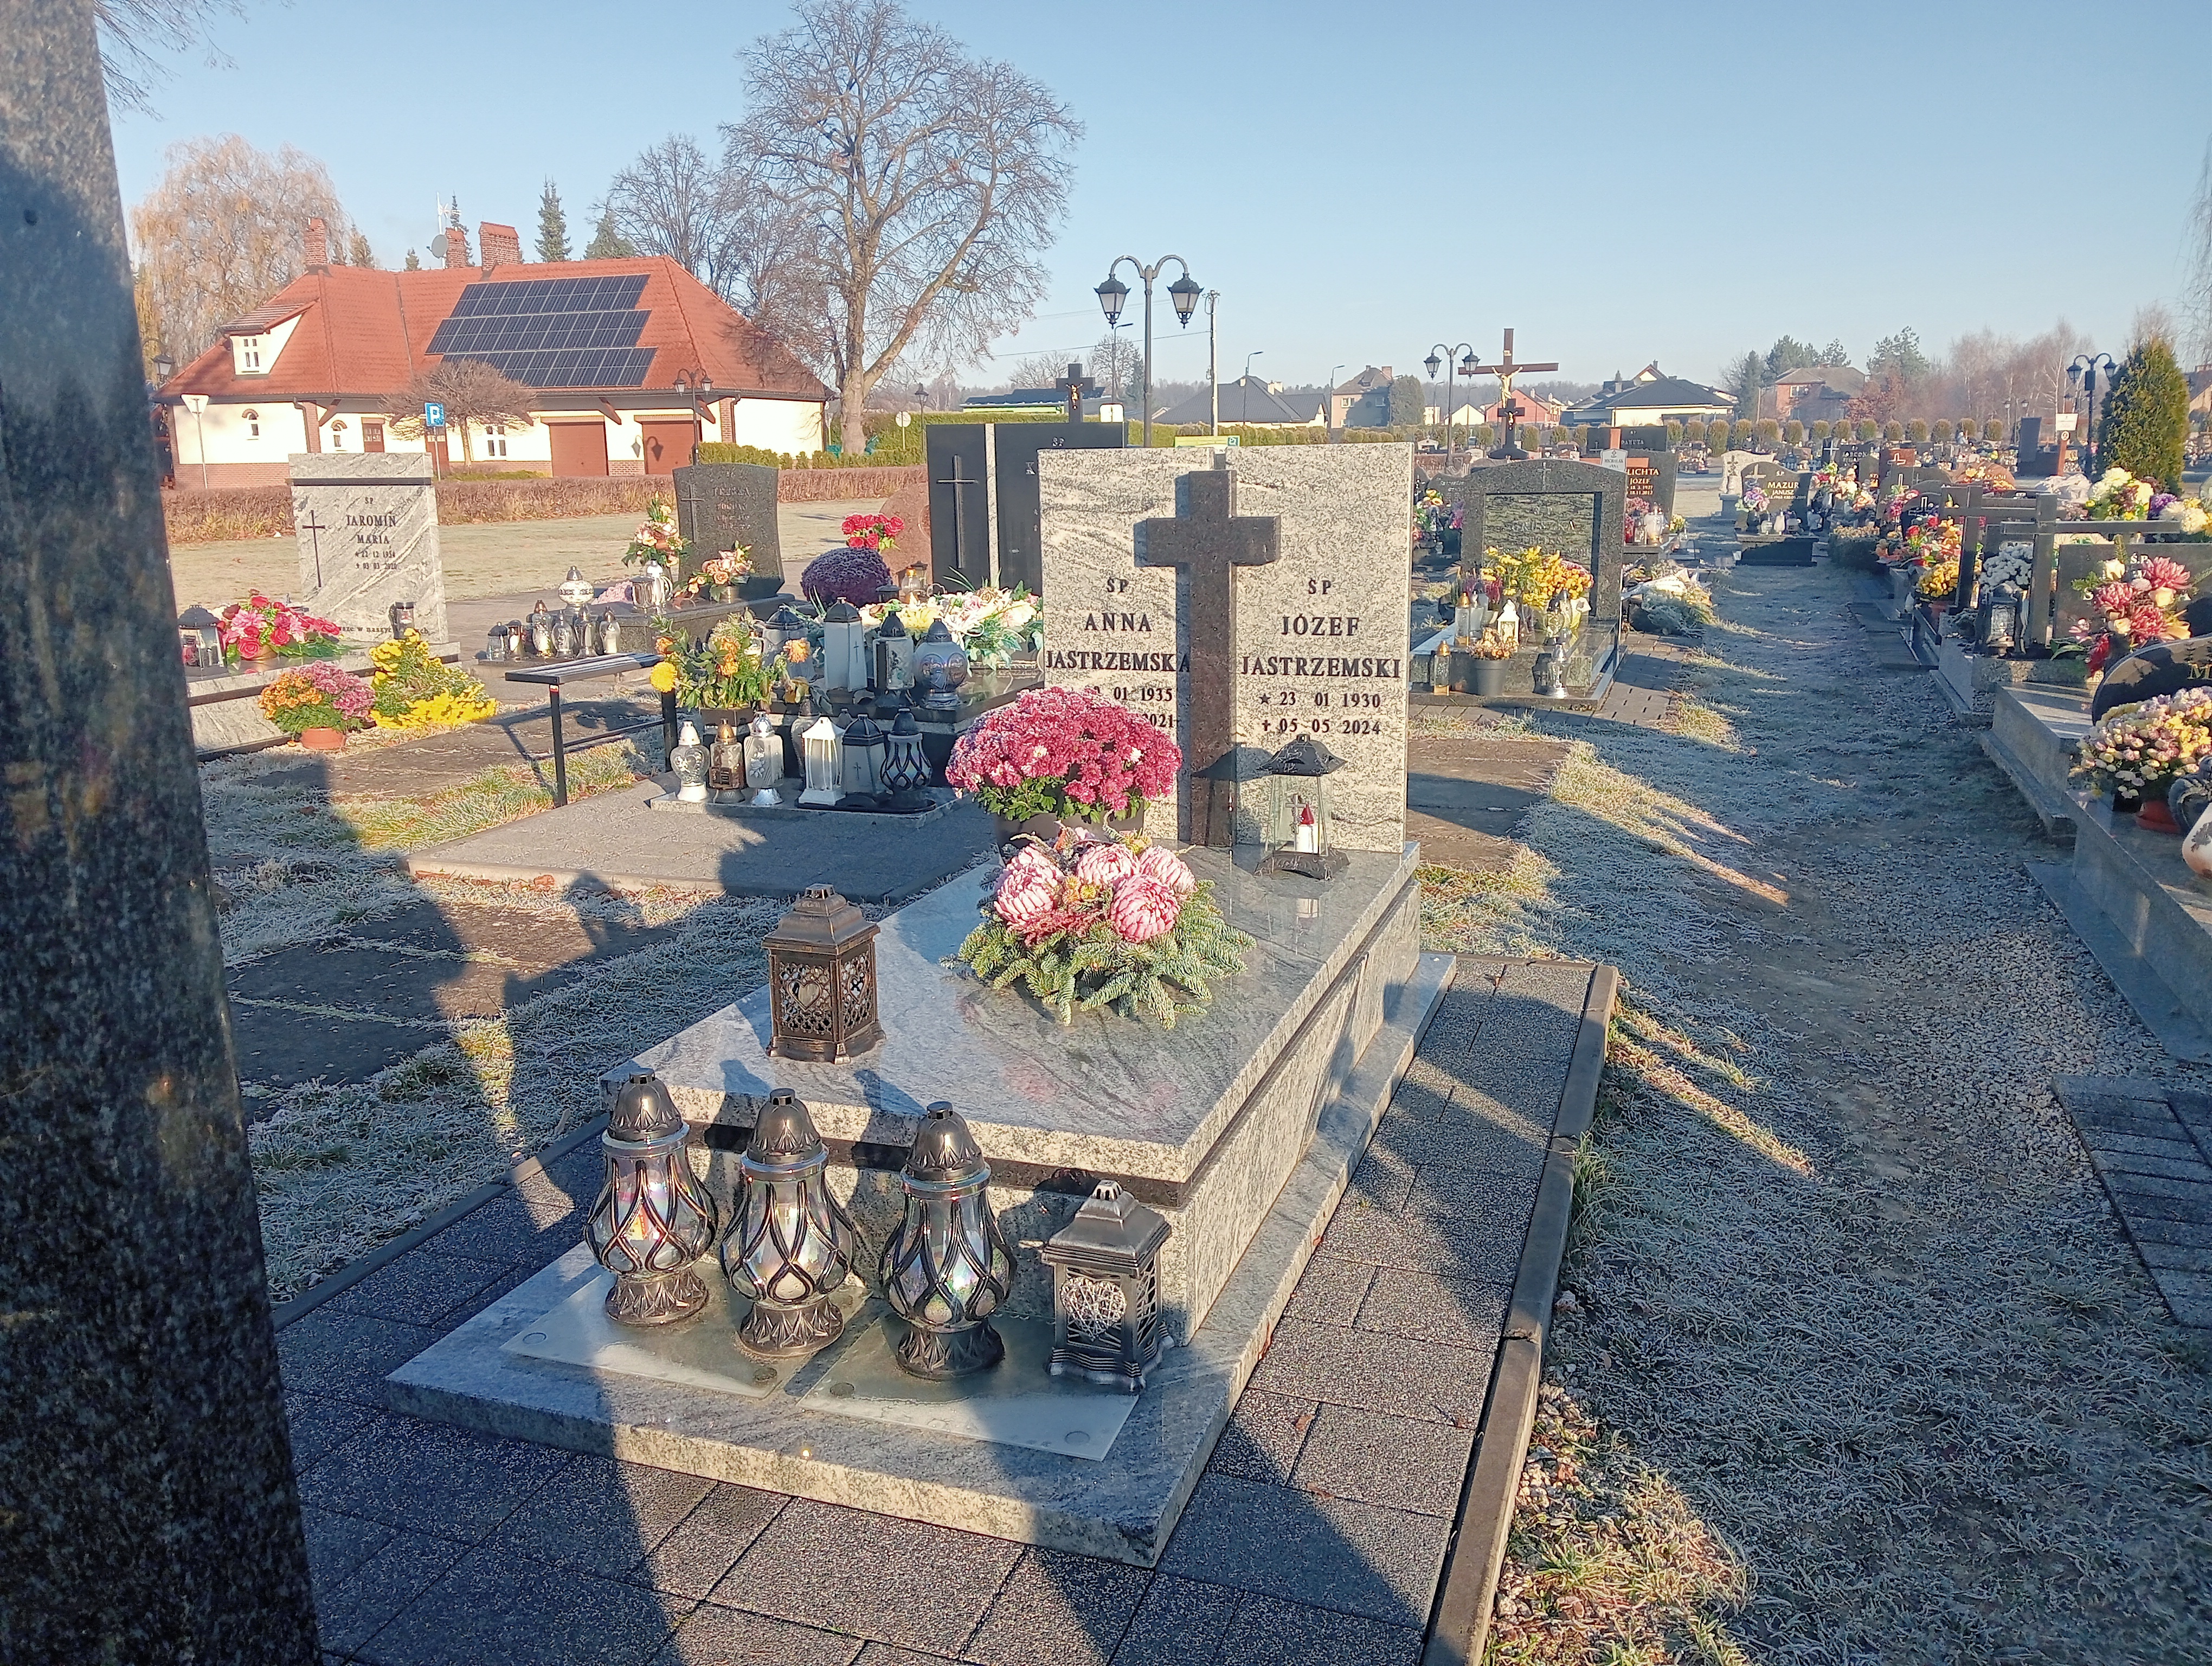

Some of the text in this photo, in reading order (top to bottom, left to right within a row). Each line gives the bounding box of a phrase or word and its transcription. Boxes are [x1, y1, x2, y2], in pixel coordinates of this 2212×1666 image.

[429, 406, 440, 424] P
[357, 534, 390, 544] MARIA
[1085, 613, 1152, 632] ANNA
[1282, 613, 1359, 636] JÓZEF
[1046, 650, 1190, 672] JASTRZEMSKA
[1241, 656, 1400, 678] JASTRZEMSKI
[1114, 686, 1128, 700] 01
[1141, 687, 1173, 701] 1935
[1279, 691, 1381, 708] 23 01 1930
[1279, 718, 1381, 734] 05 05 2024
